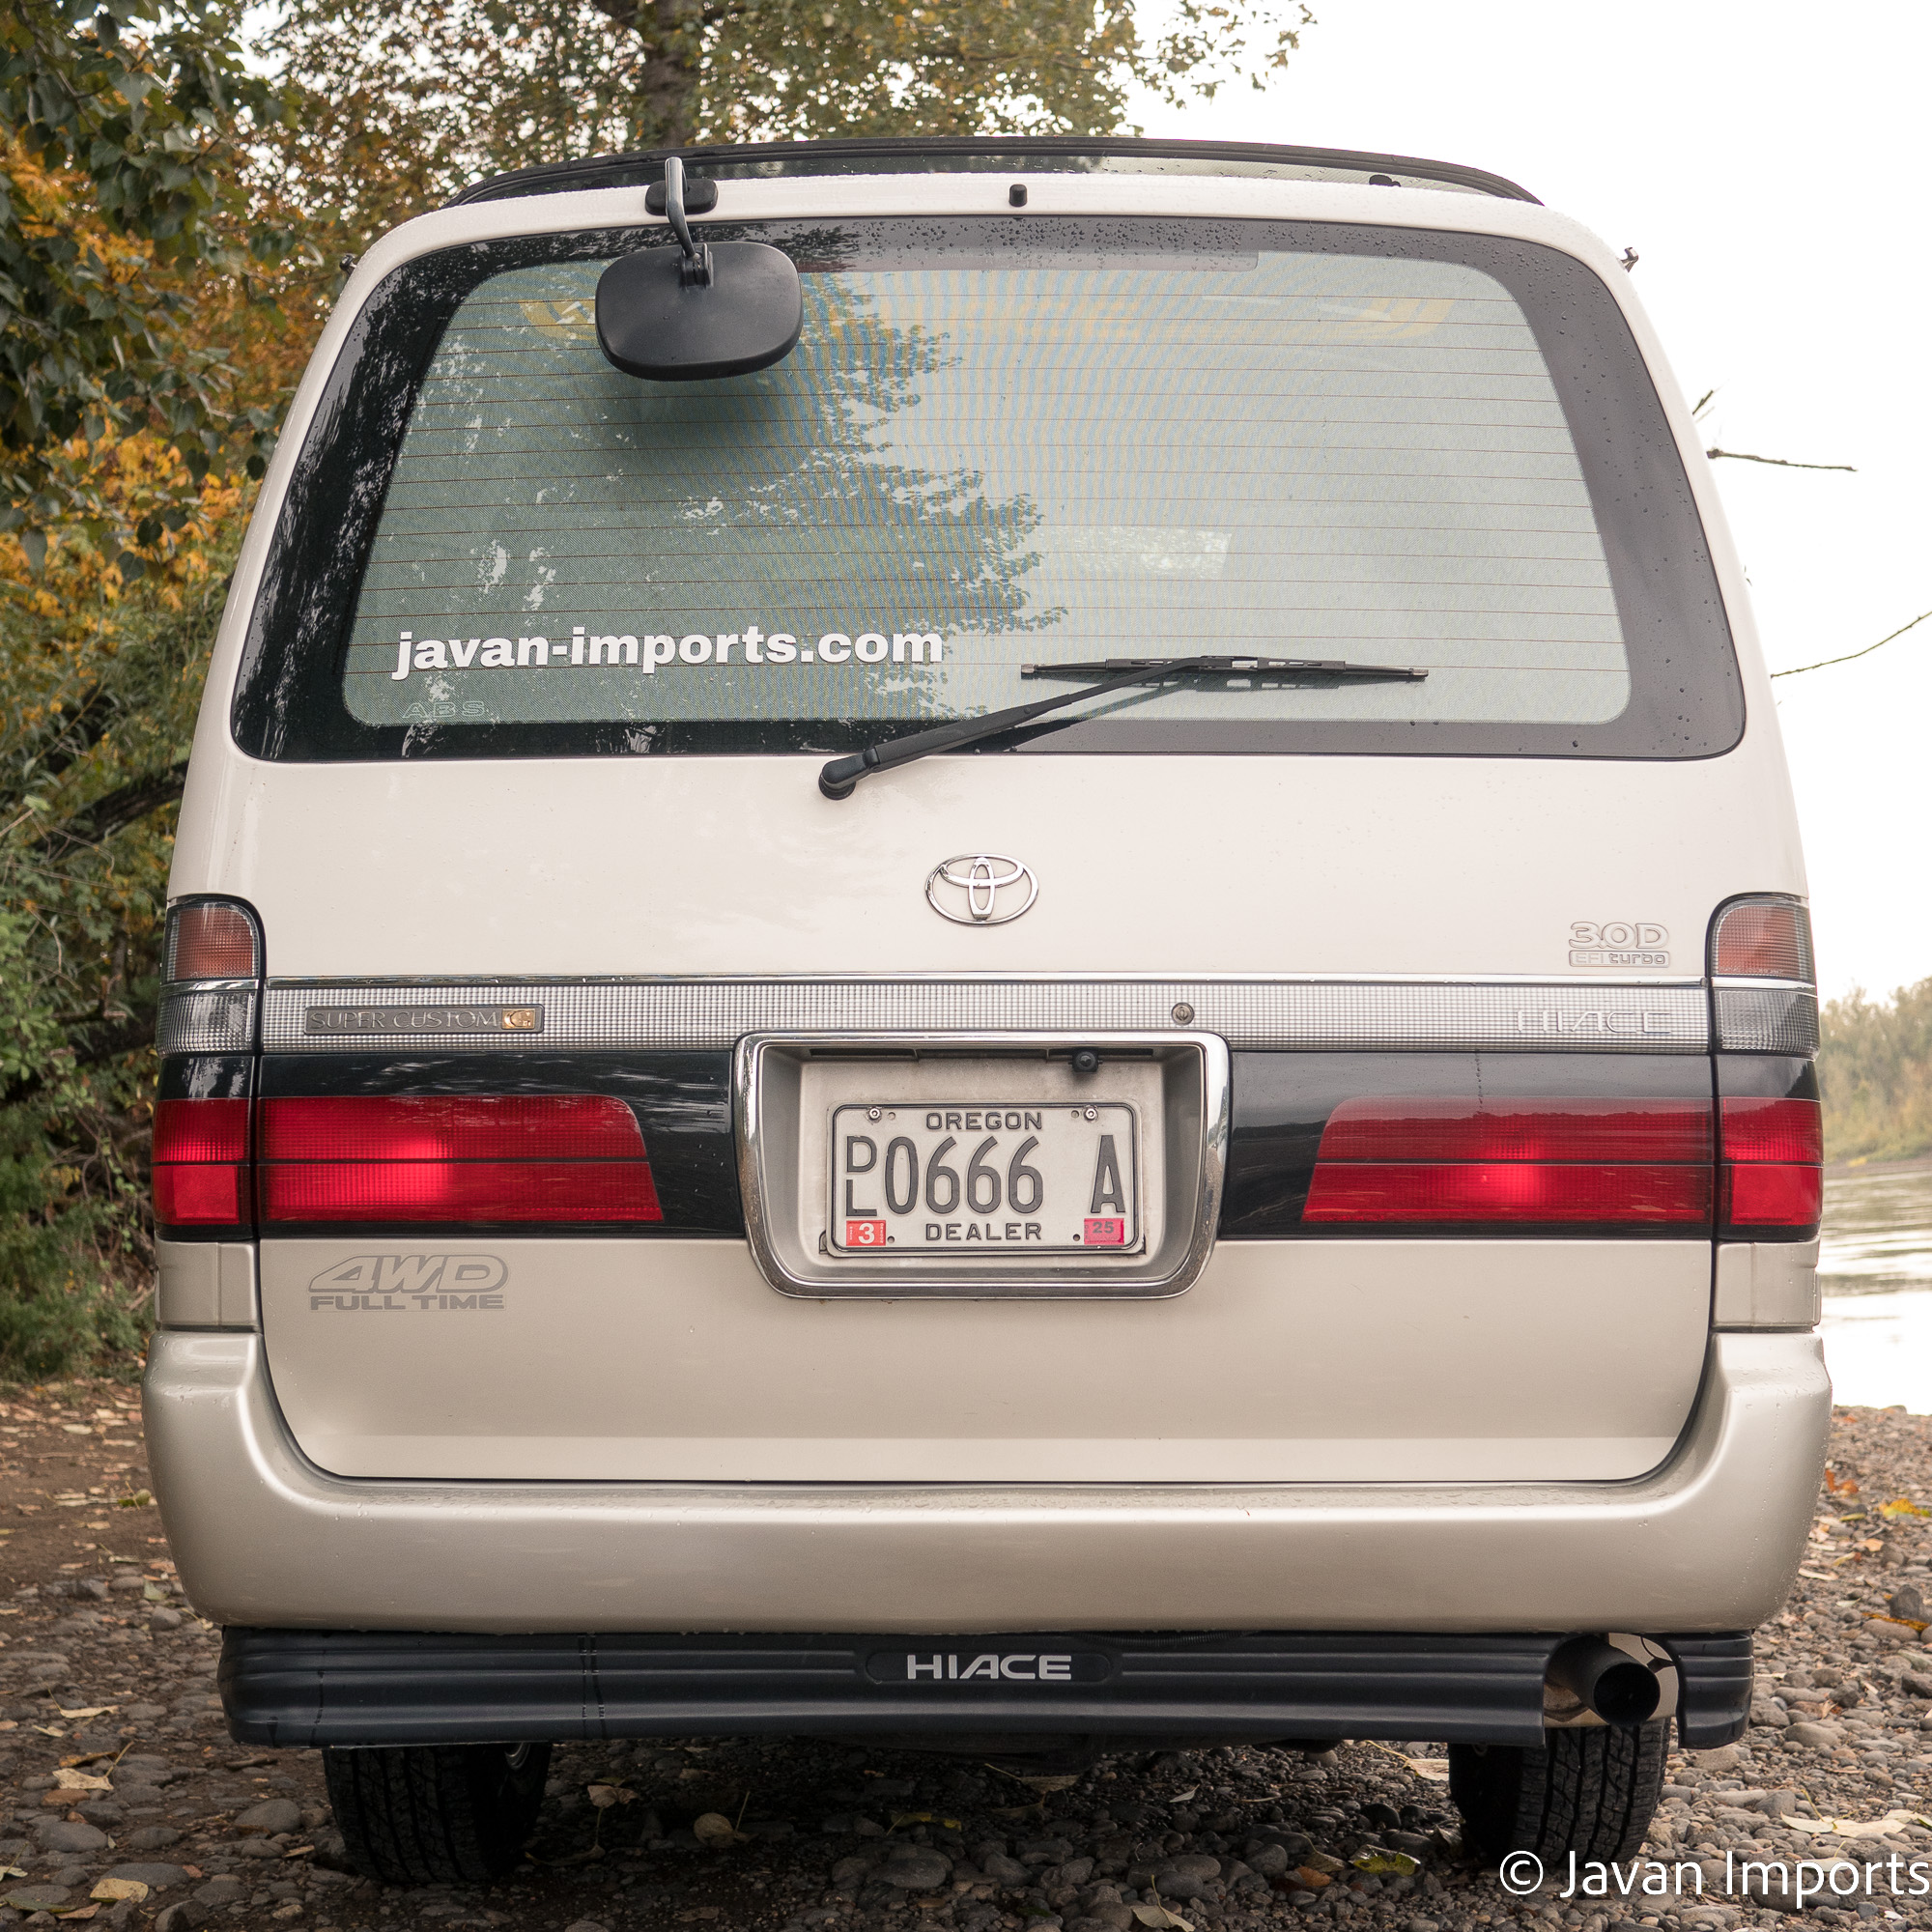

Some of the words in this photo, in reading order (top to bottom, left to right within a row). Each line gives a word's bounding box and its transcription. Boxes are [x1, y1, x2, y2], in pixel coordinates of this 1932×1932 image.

[391, 625, 944, 681] javan-imports.com
[402, 700, 485, 719] ABS
[1568, 921, 1669, 950] 3.0D
[1575, 952, 1605, 964] EFI
[1608, 952, 1665, 964] turbo
[309, 1011, 385, 1029] SUPER
[393, 1010, 498, 1028] CUSTOM
[1517, 1010, 1671, 1034] HIACE
[925, 1112, 1043, 1130] OREGON
[1090, 1134, 1126, 1214] A
[858, 1222, 875, 1244] 3
[925, 1222, 1042, 1240] DEALER
[1093, 1221, 1114, 1234] 25
[307, 1254, 509, 1294] 4WD
[310, 1294, 406, 1311] FULL
[412, 1293, 505, 1310] TIME
[907, 1654, 1072, 1680] HIACE
